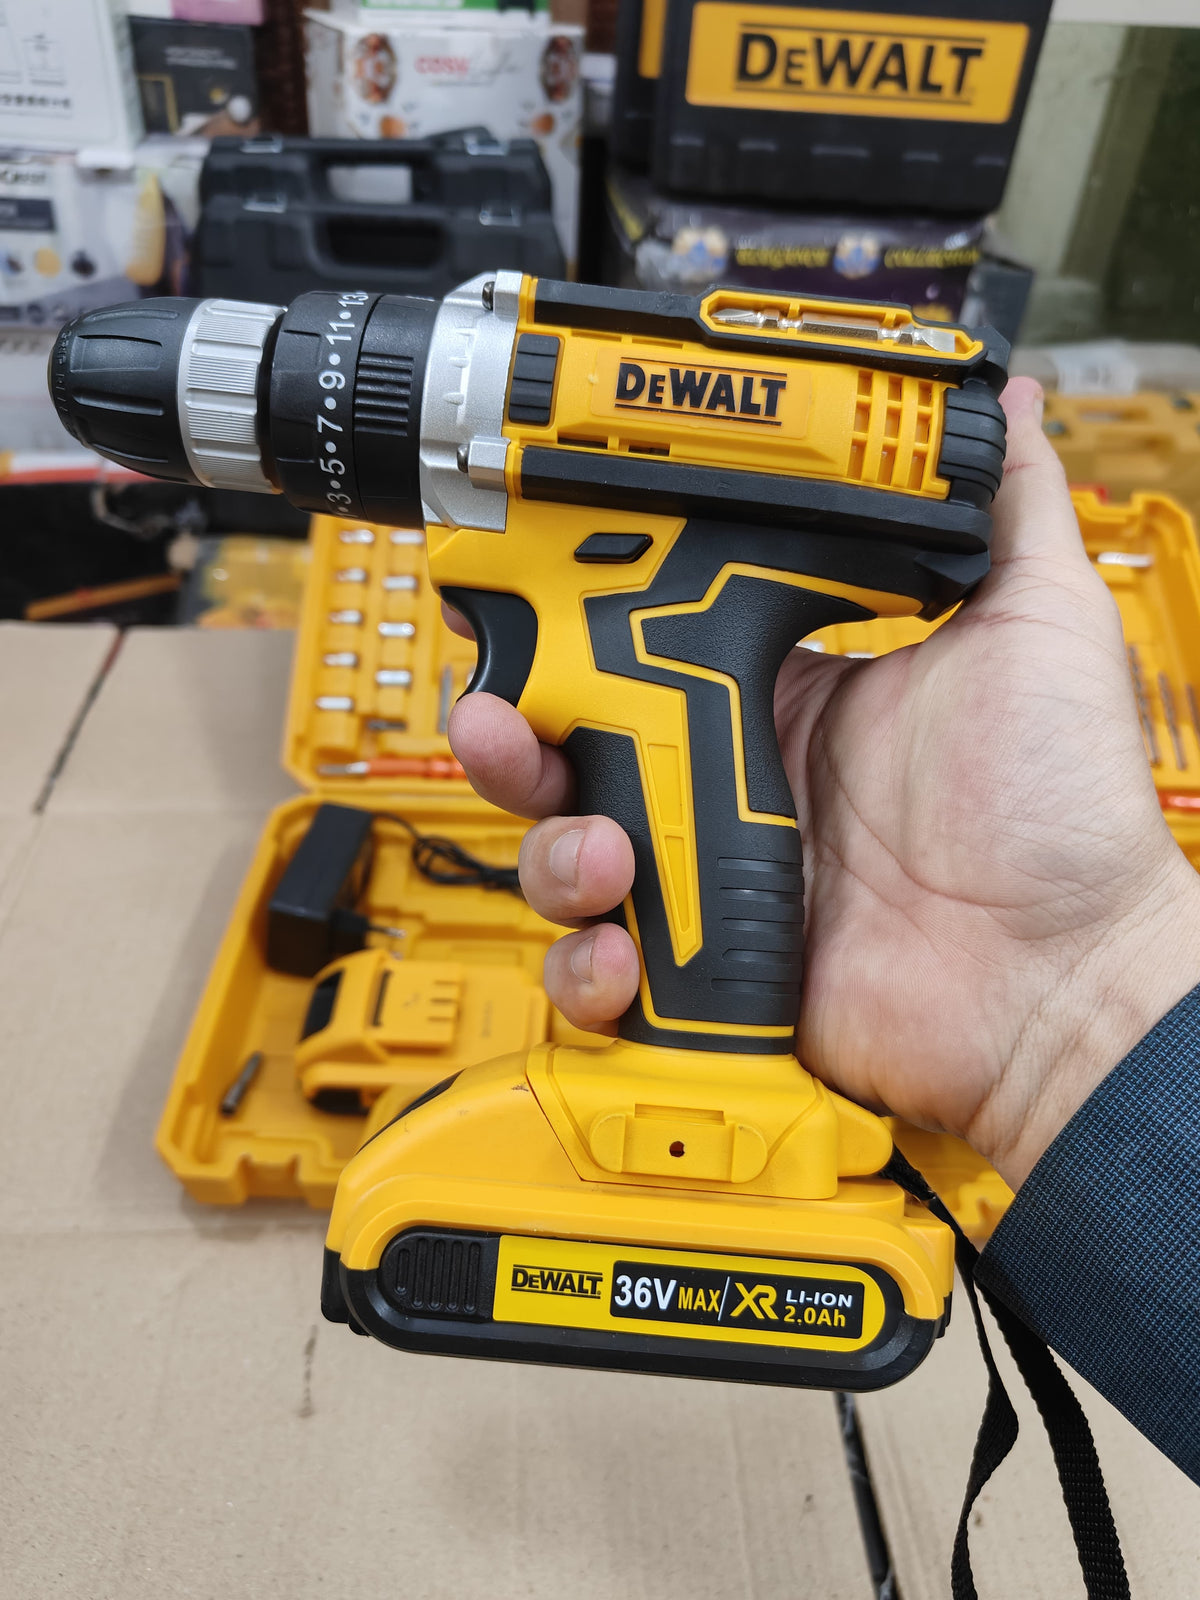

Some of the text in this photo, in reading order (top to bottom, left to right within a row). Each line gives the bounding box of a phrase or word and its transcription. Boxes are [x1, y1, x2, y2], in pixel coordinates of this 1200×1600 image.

[338, 291, 369, 307] 13
[326, 322, 355, 345] 11
[319, 370, 346, 389] 9
[317, 414, 343, 433] 7
[320, 458, 345, 475] 5
[614, 1274, 779, 1320] 36V MAX XR
[786, 1289, 853, 1308] LI-ION
[783, 1305, 846, 1327] 2.0Ah
